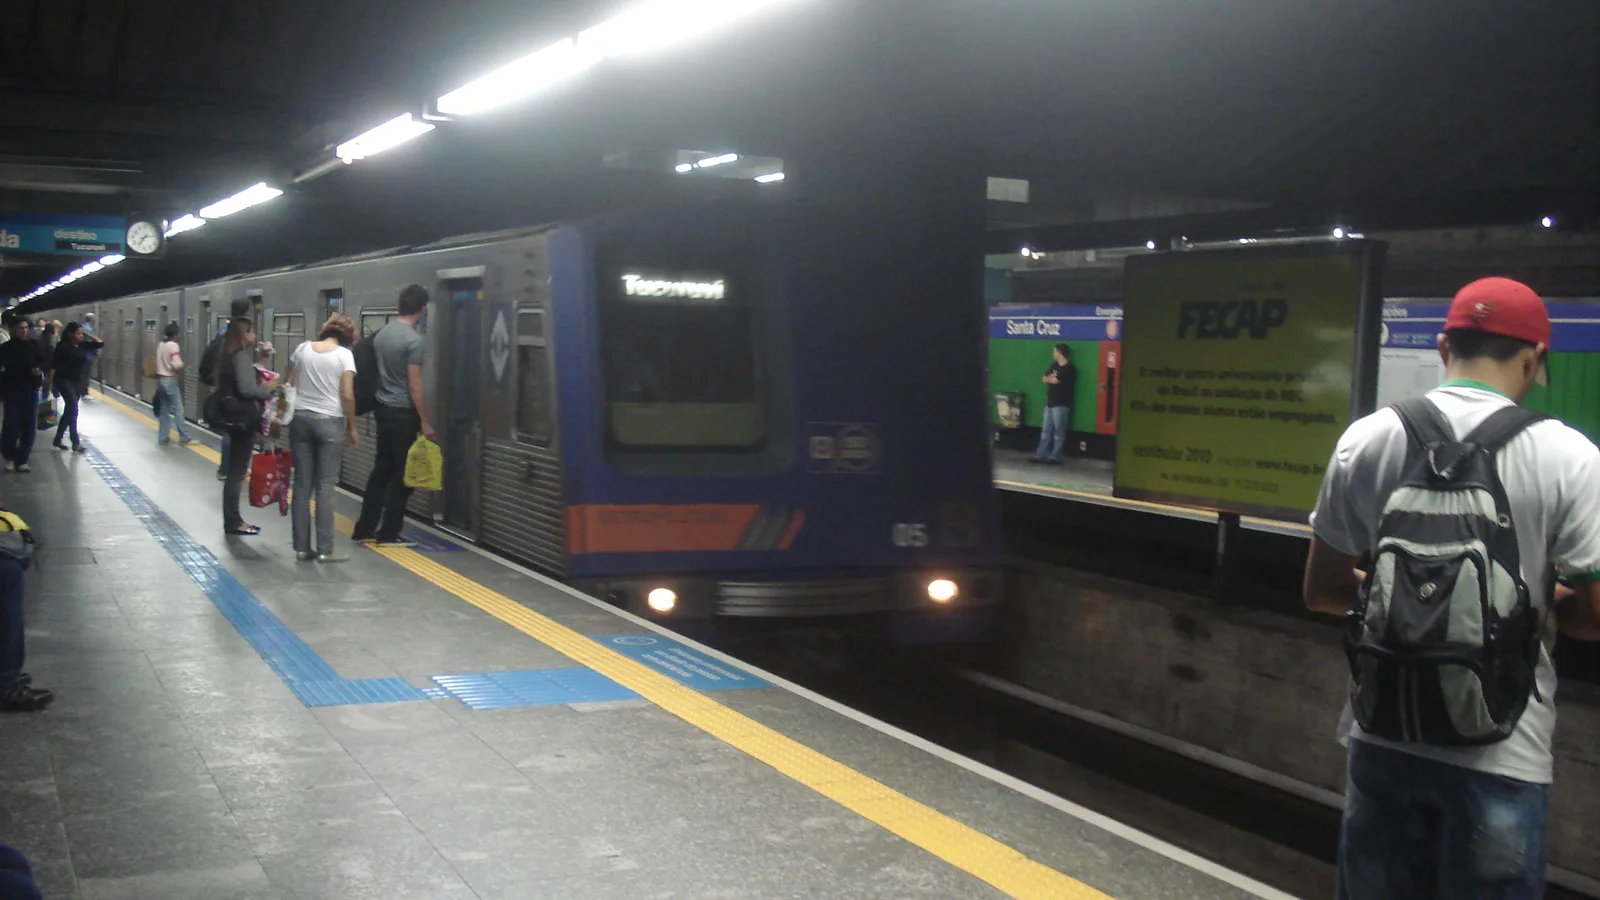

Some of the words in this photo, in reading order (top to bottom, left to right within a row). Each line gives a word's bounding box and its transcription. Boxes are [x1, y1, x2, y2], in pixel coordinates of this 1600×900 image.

[54, 230, 97, 240] destino
[1177, 299, 1288, 339] FECAP
[1006, 319, 1034, 335] Santa
[1036, 319, 1061, 336] Cruz
[1149, 366, 1182, 378] melhor
[1184, 369, 1215, 380] centro
[1216, 367, 1283, 381] universitário
[1171, 384, 1199, 397] Brasil
[1202, 404, 1235, 416] alunos
[1238, 406, 1265, 419] estão
[1133, 444, 1184, 460] vestibular
[1186, 446, 1212, 463] 2010
